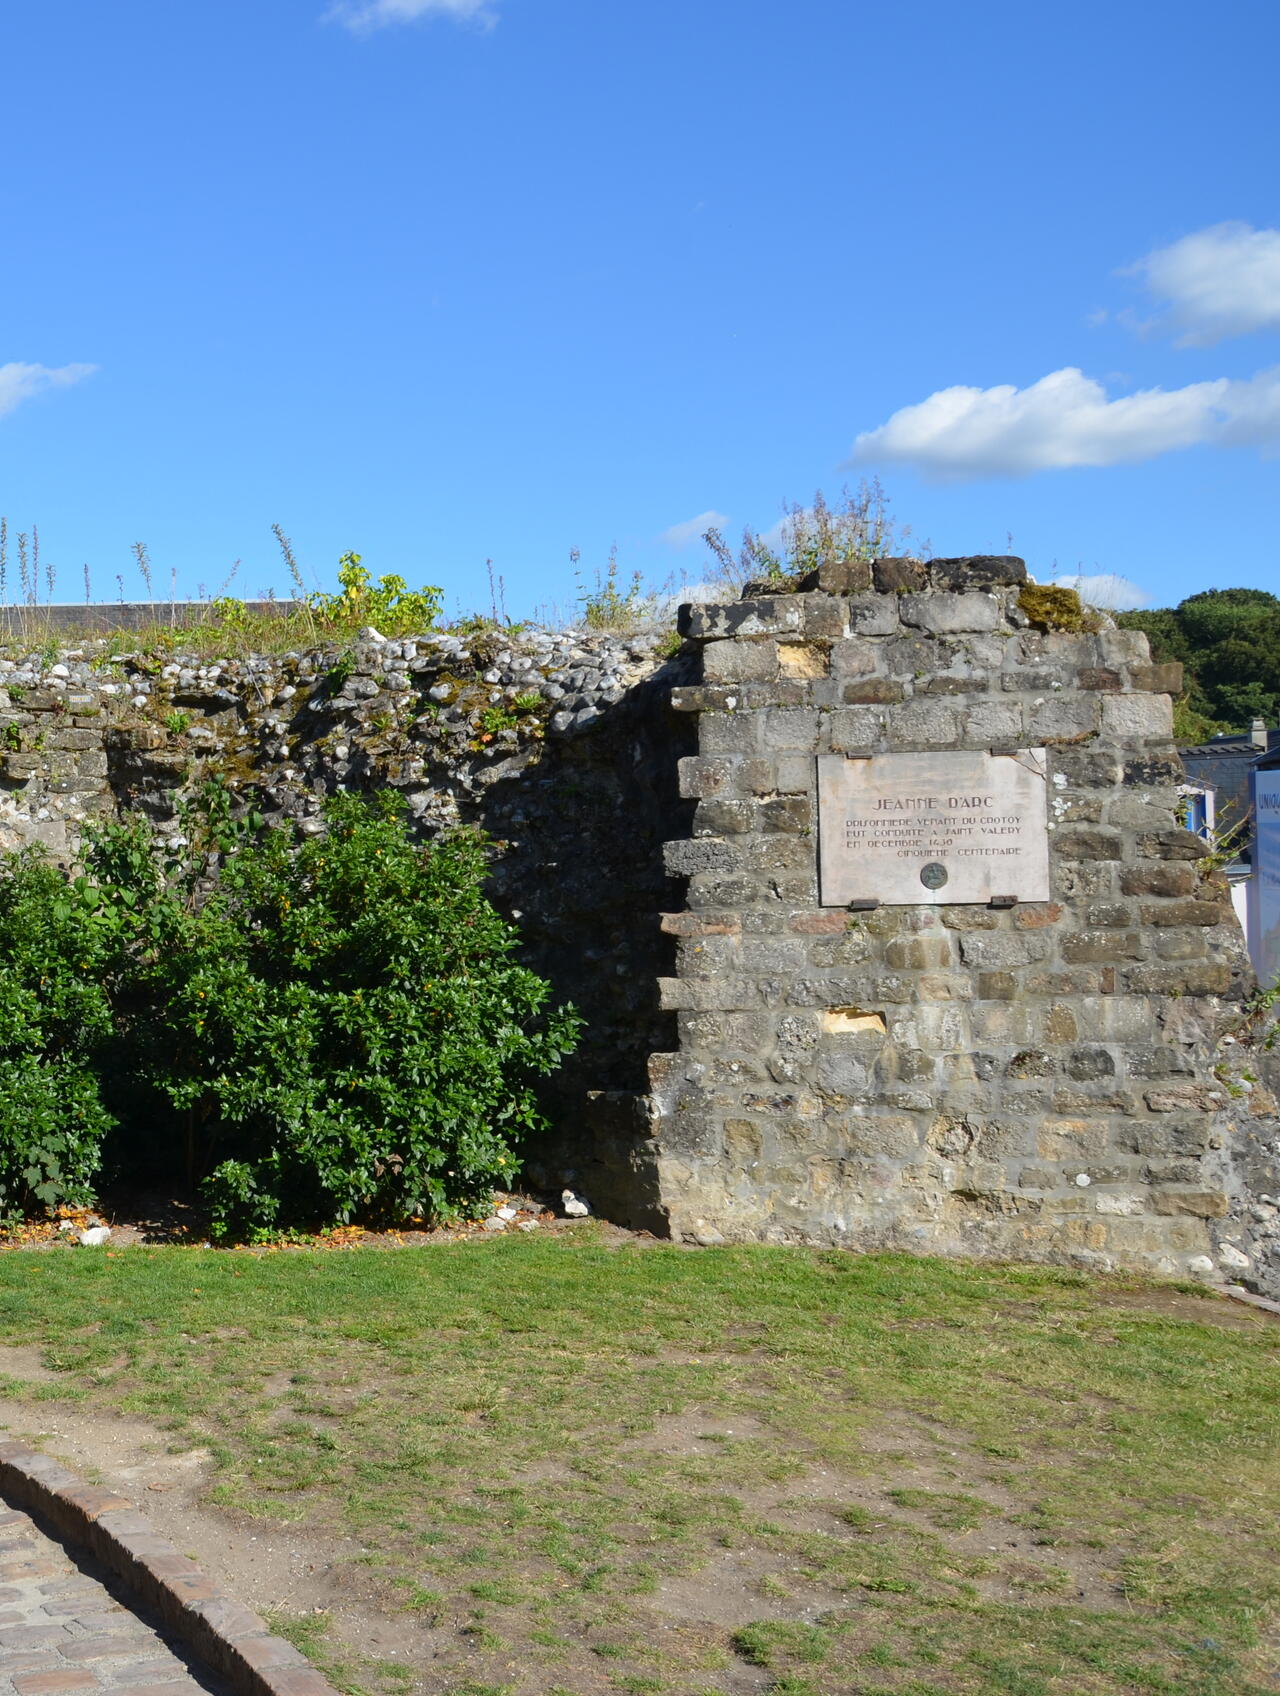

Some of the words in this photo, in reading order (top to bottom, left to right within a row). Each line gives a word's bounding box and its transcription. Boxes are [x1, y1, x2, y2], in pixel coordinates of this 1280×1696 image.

[872, 797, 938, 811] JEANNE
[948, 796, 994, 809] D'ARC
[917, 817, 957, 826] VENANT
[962, 817, 976, 825] DU
[980, 816, 1021, 824] CROTOY
[874, 829, 925, 838] CONDUITE
[944, 828, 974, 836] SAINT
[981, 827, 1021, 835] VALERY
[846, 840, 861, 849] EN
[868, 839, 922, 848] DECEMBRE
[897, 850, 949, 858] CINQUIEME
[958, 848, 1021, 857] CENTENAIRE
